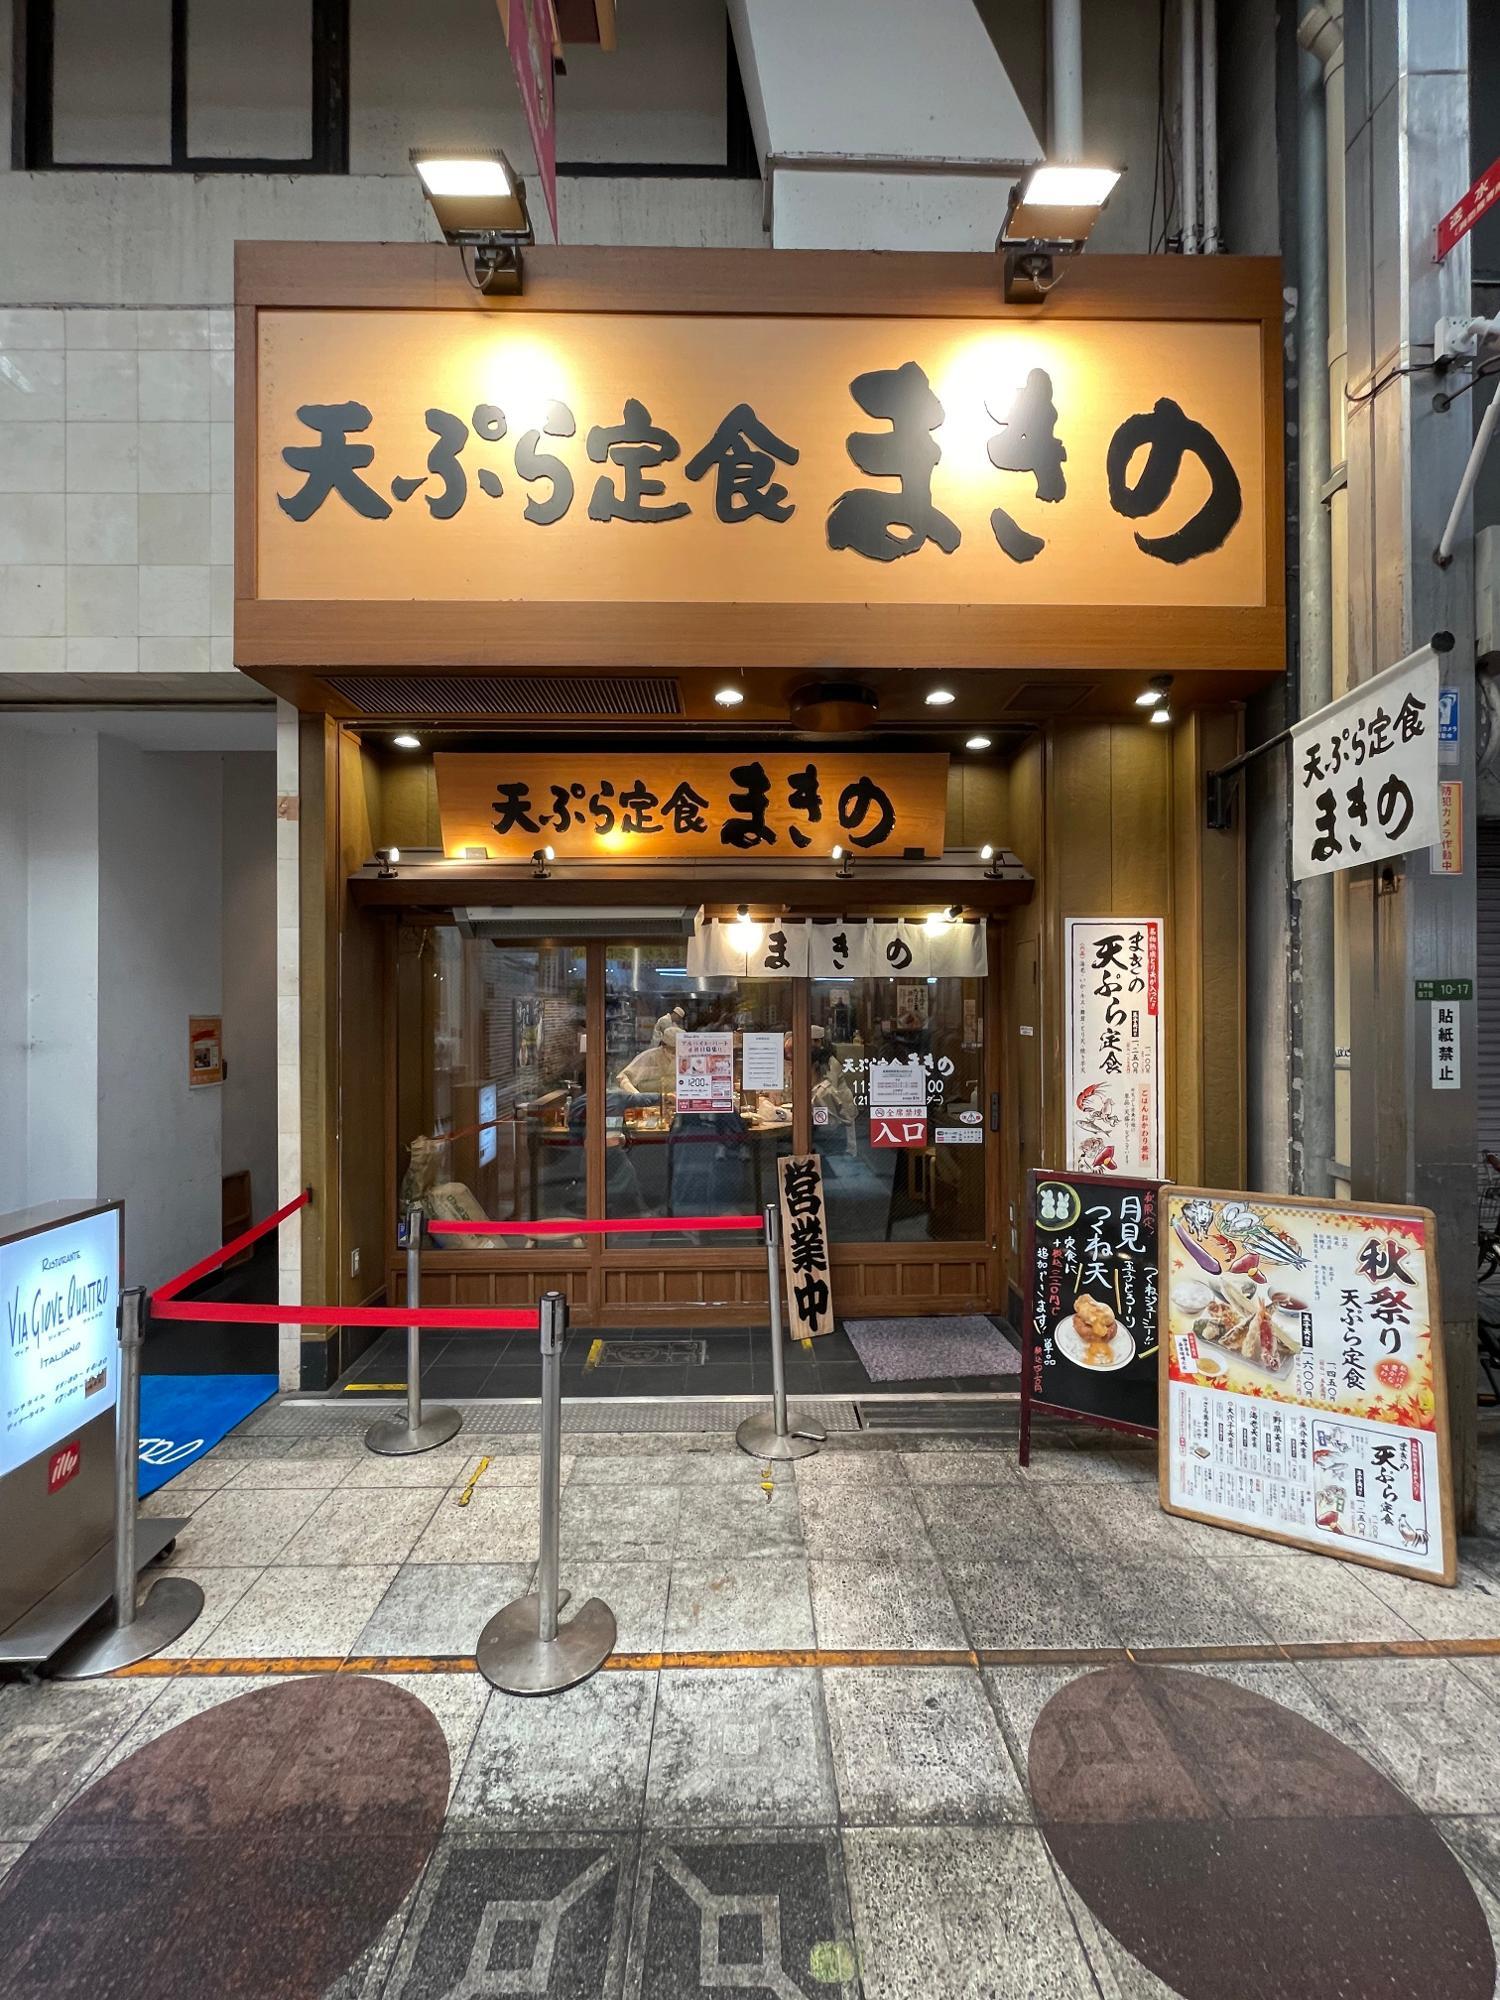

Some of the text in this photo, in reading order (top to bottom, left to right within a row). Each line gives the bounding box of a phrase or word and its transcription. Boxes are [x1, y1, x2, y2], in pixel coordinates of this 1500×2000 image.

[275, 360, 1243, 565] 天ぷら定食 まきの
[1302, 692, 1427, 788] 天ぷら定食
[491, 761, 897, 850] 天ぷら定食 まきの
[1310, 773, 1414, 862] まきの
[765, 931, 913, 970] まきの
[1129, 931, 1145, 993] まきの
[1441, 984, 1469, 995] 10-17
[1091, 935, 1128, 1075] 天ぷら定食
[1438, 1008, 1454, 1082] 貼紙禁止
[873, 1122, 925, 1144] 入口
[886, 1108, 923, 1117] 全席禁煙
[784, 1159, 830, 1332] 営業中
[1082, 1205, 1114, 1290] つくね天
[1115, 1196, 1146, 1253] 月見
[1357, 1237, 1418, 1355] 秋祭り
[1339, 1288, 1367, 1391] 天ぷら定食
[51, 1450, 78, 1484] illy
[1371, 1445, 1400, 1526] 天ぷら定食
